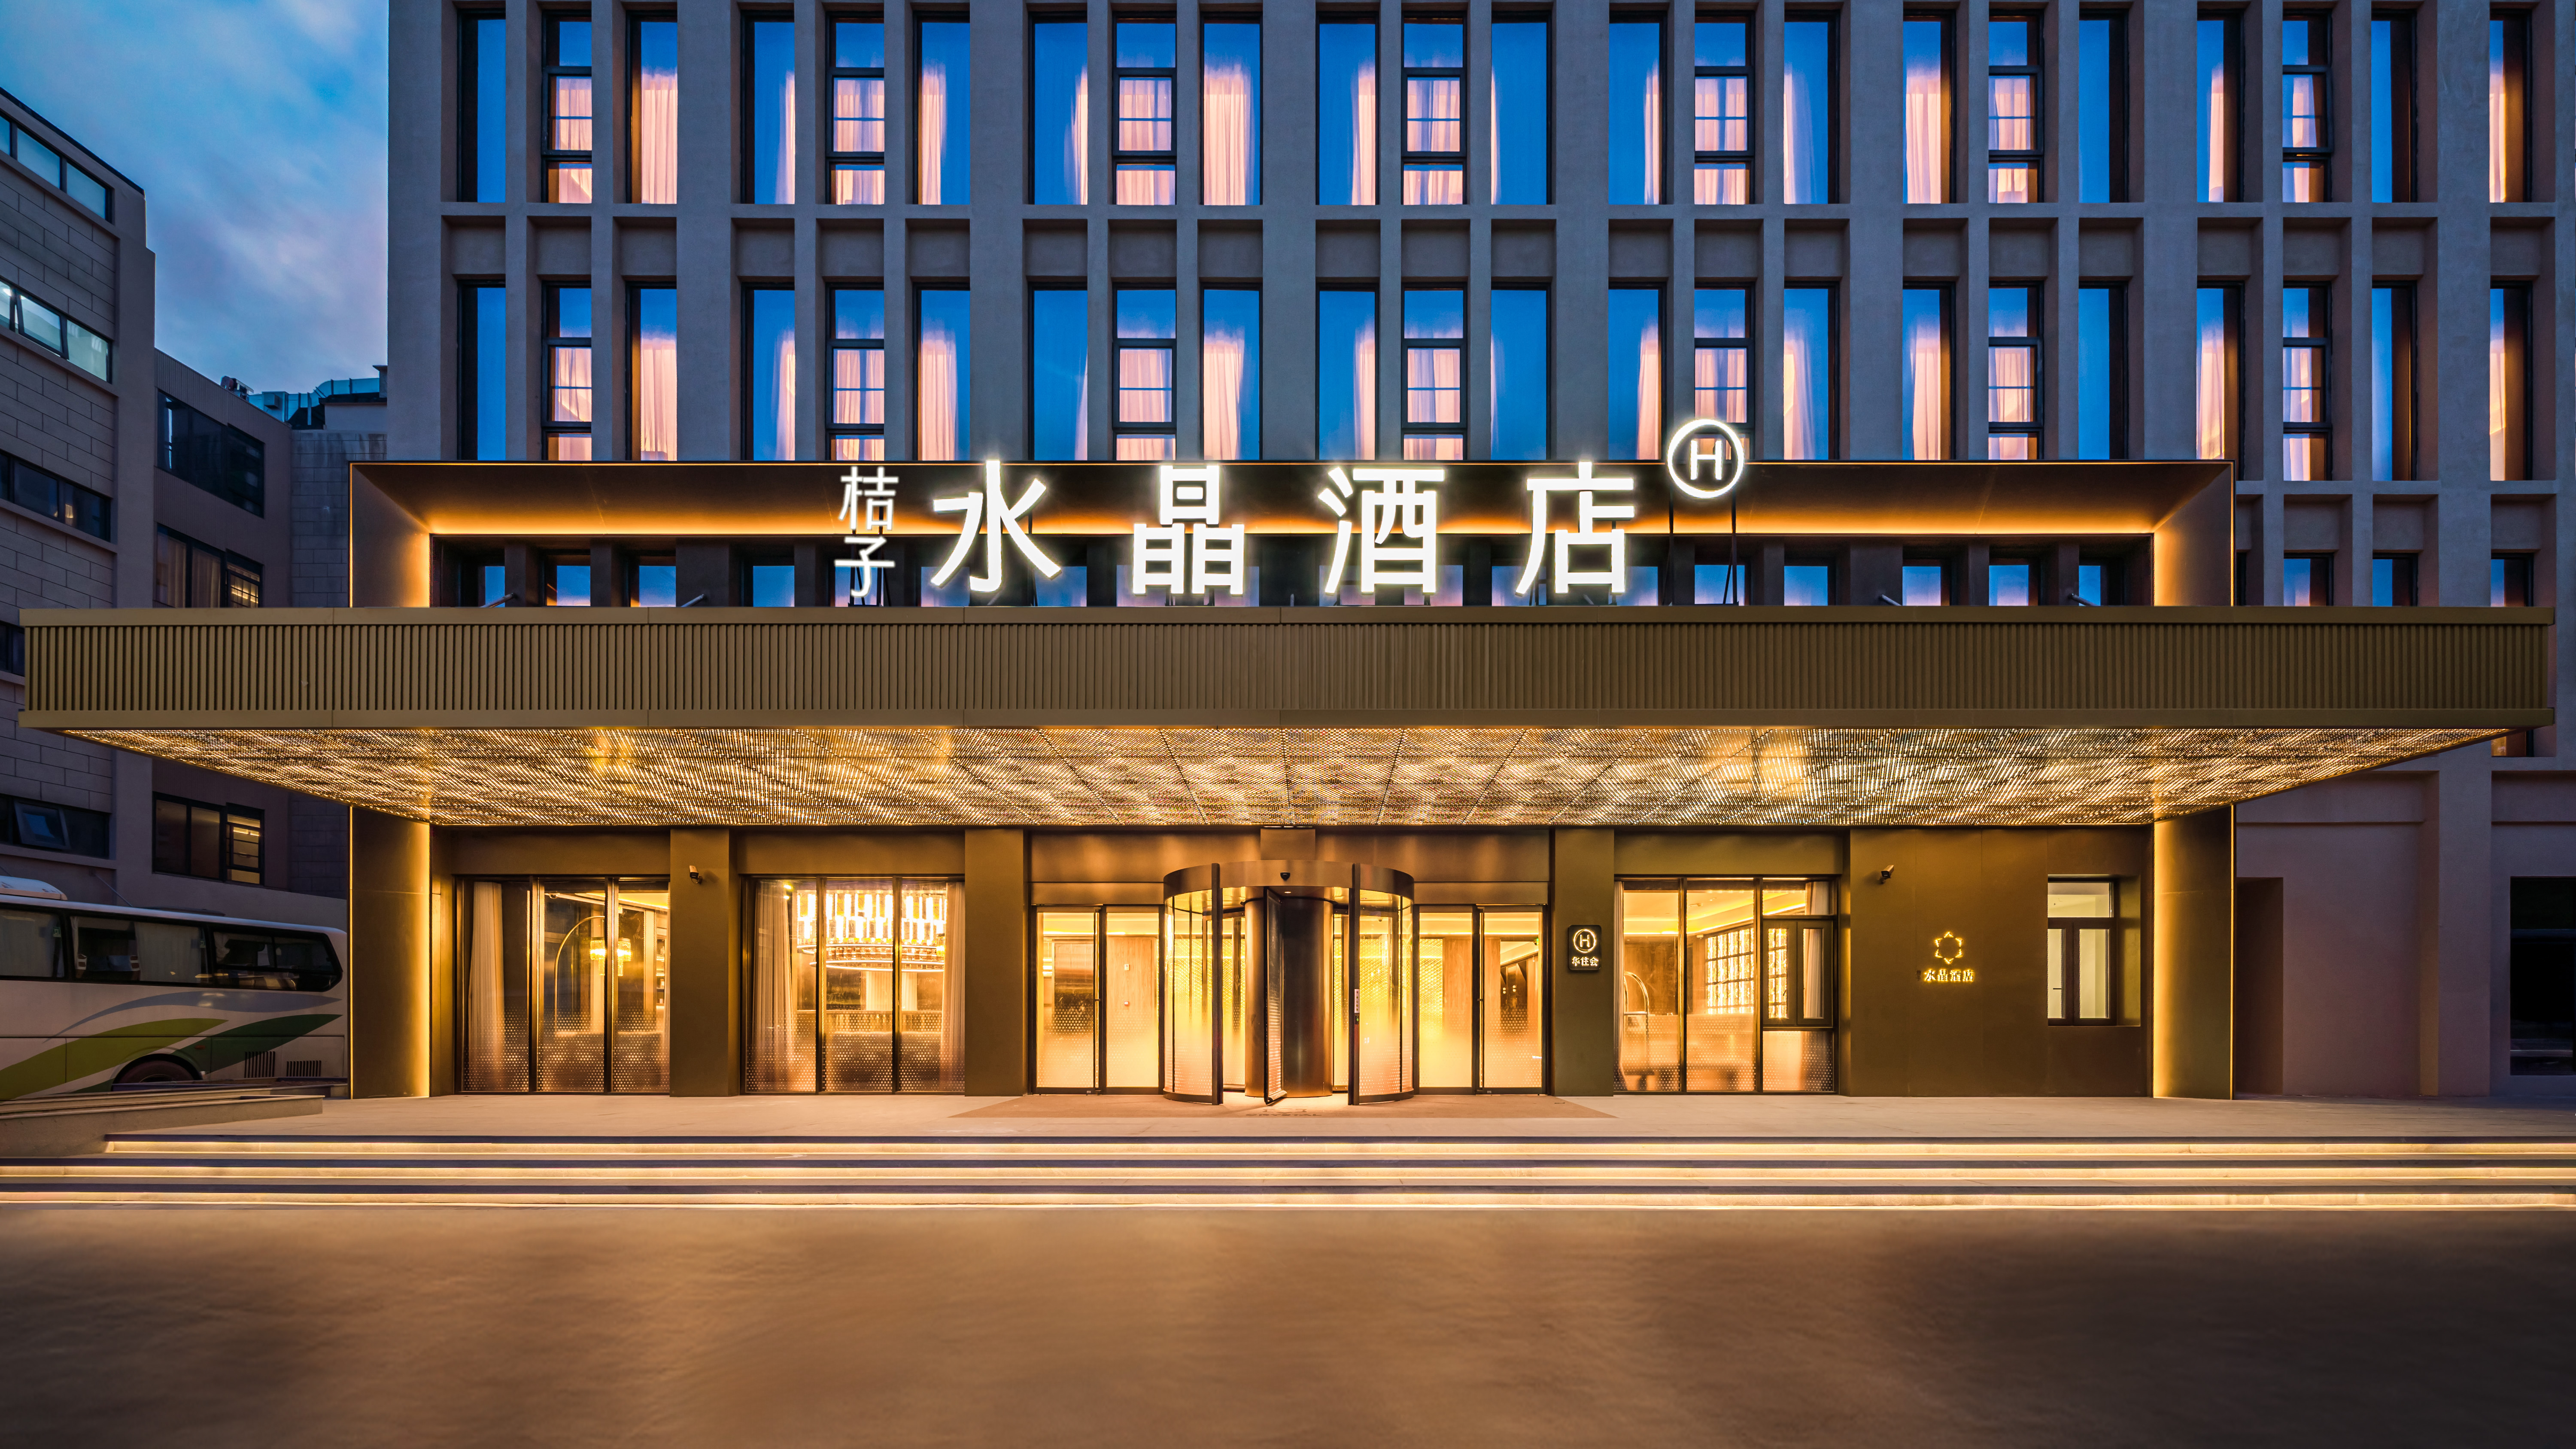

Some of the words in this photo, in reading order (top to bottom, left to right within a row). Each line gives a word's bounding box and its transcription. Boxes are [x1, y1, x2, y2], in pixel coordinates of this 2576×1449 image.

[1690, 439, 1723, 480] H
[835, 466, 898, 597] 桔子
[930, 459, 1635, 595] 水晶酒店
[1580, 934, 1590, 948] H
[1572, 956, 1599, 966] 华住会
[1924, 969, 1974, 981] 水晶酒店
